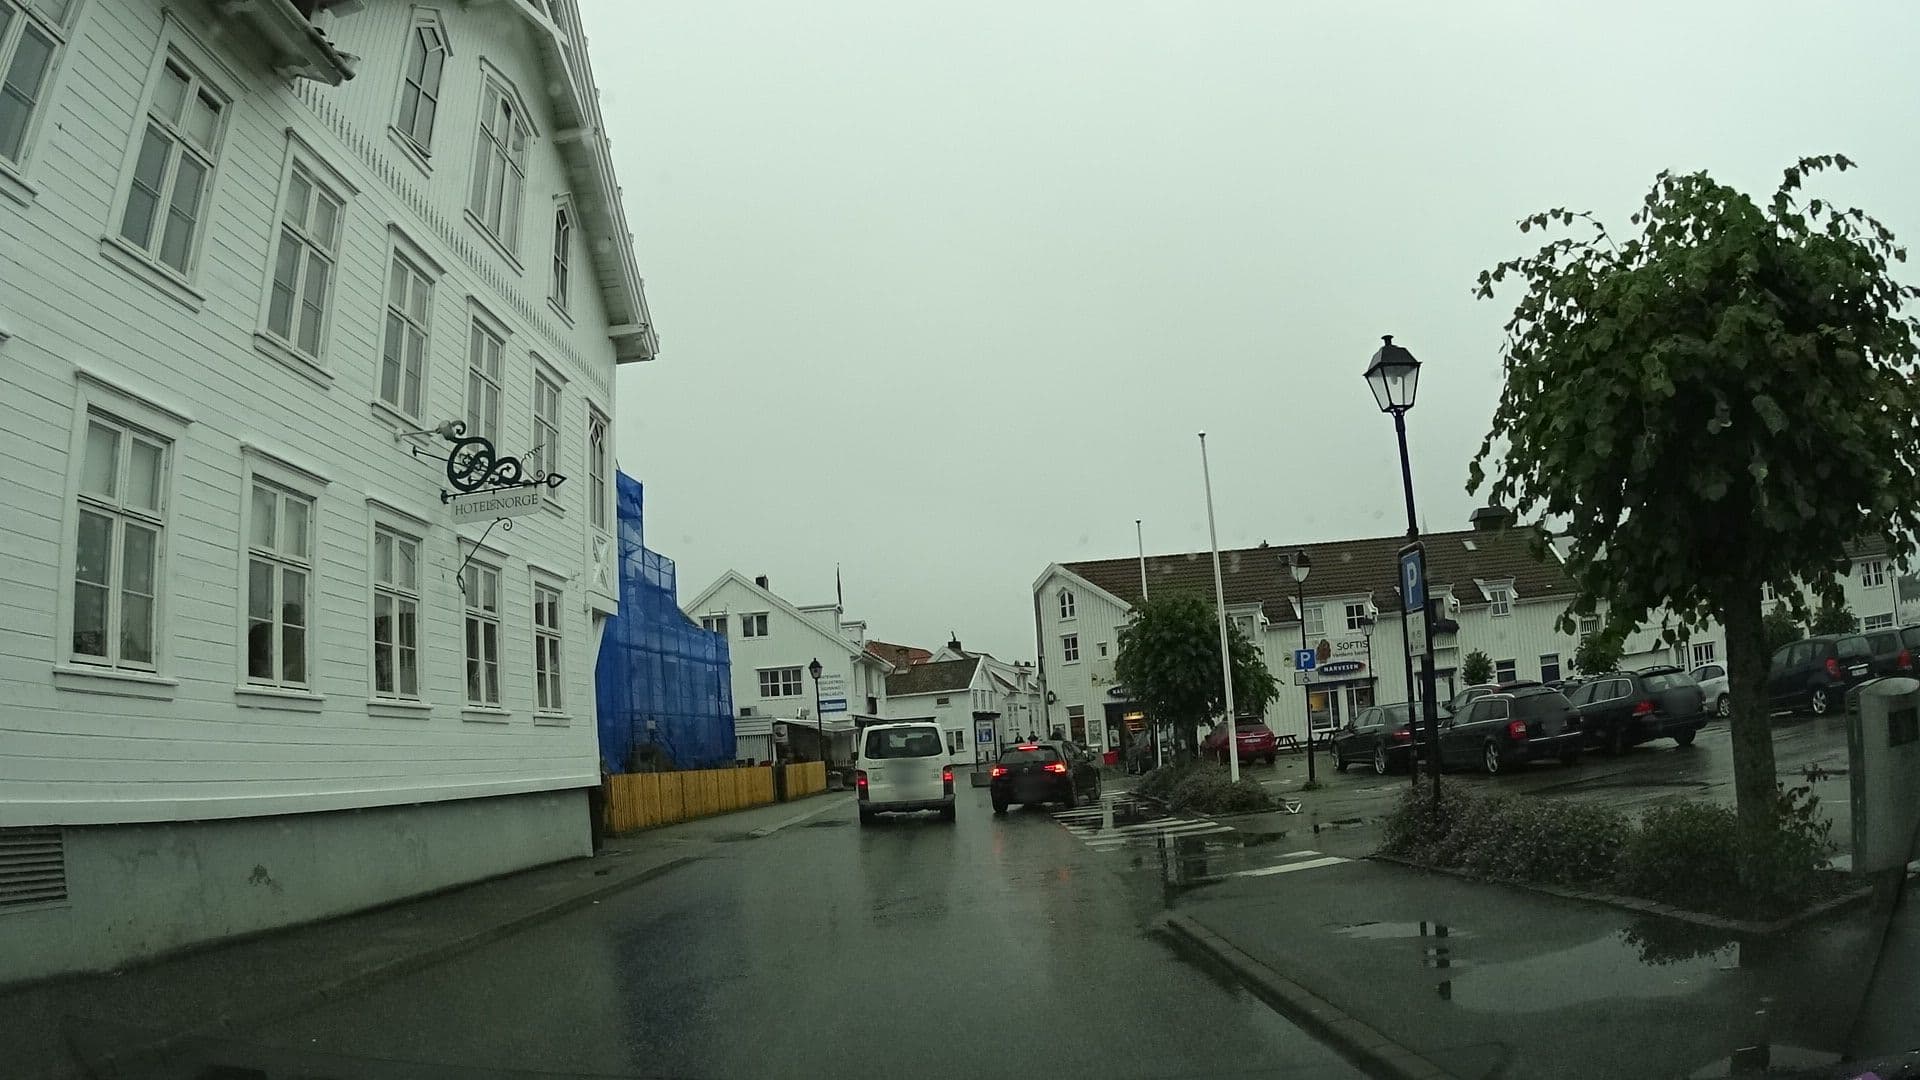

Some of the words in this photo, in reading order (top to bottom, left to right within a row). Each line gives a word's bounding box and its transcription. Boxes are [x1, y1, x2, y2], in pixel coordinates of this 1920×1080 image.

[455, 500, 493, 515] HOTEL
[496, 494, 538, 511] NORGE
[1407, 562, 1417, 604] P
[1300, 652, 1311, 667] P
[1323, 663, 1359, 673] NARVESEN
